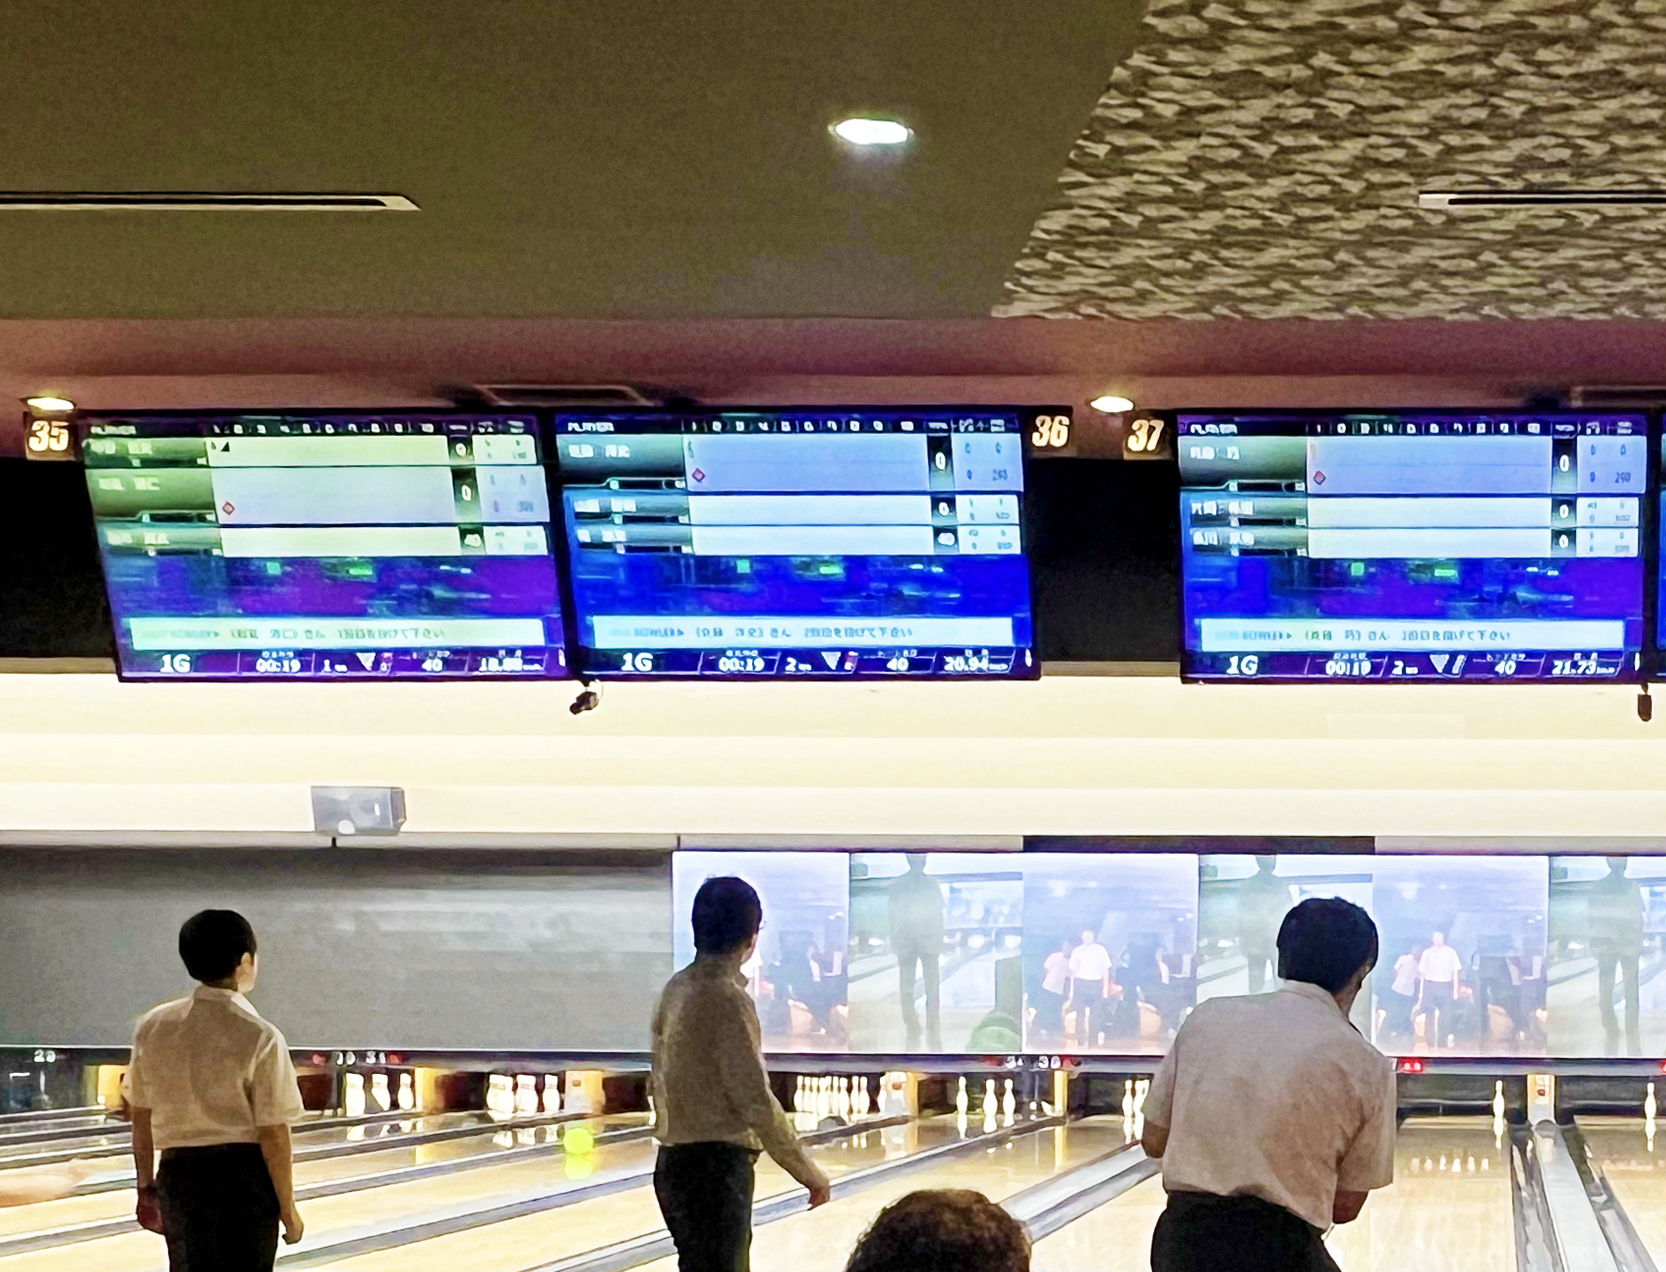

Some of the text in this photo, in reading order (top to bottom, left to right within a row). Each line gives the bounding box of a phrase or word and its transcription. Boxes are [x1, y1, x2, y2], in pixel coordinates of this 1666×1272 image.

[27, 419, 70, 452] 35
[1031, 415, 1070, 447] 36
[1127, 419, 1165, 452] 37
[160, 654, 191, 673] 1G
[621, 652, 654, 672] 1G
[1226, 655, 1259, 675] 1G
[1494, 660, 1517, 675] 40
